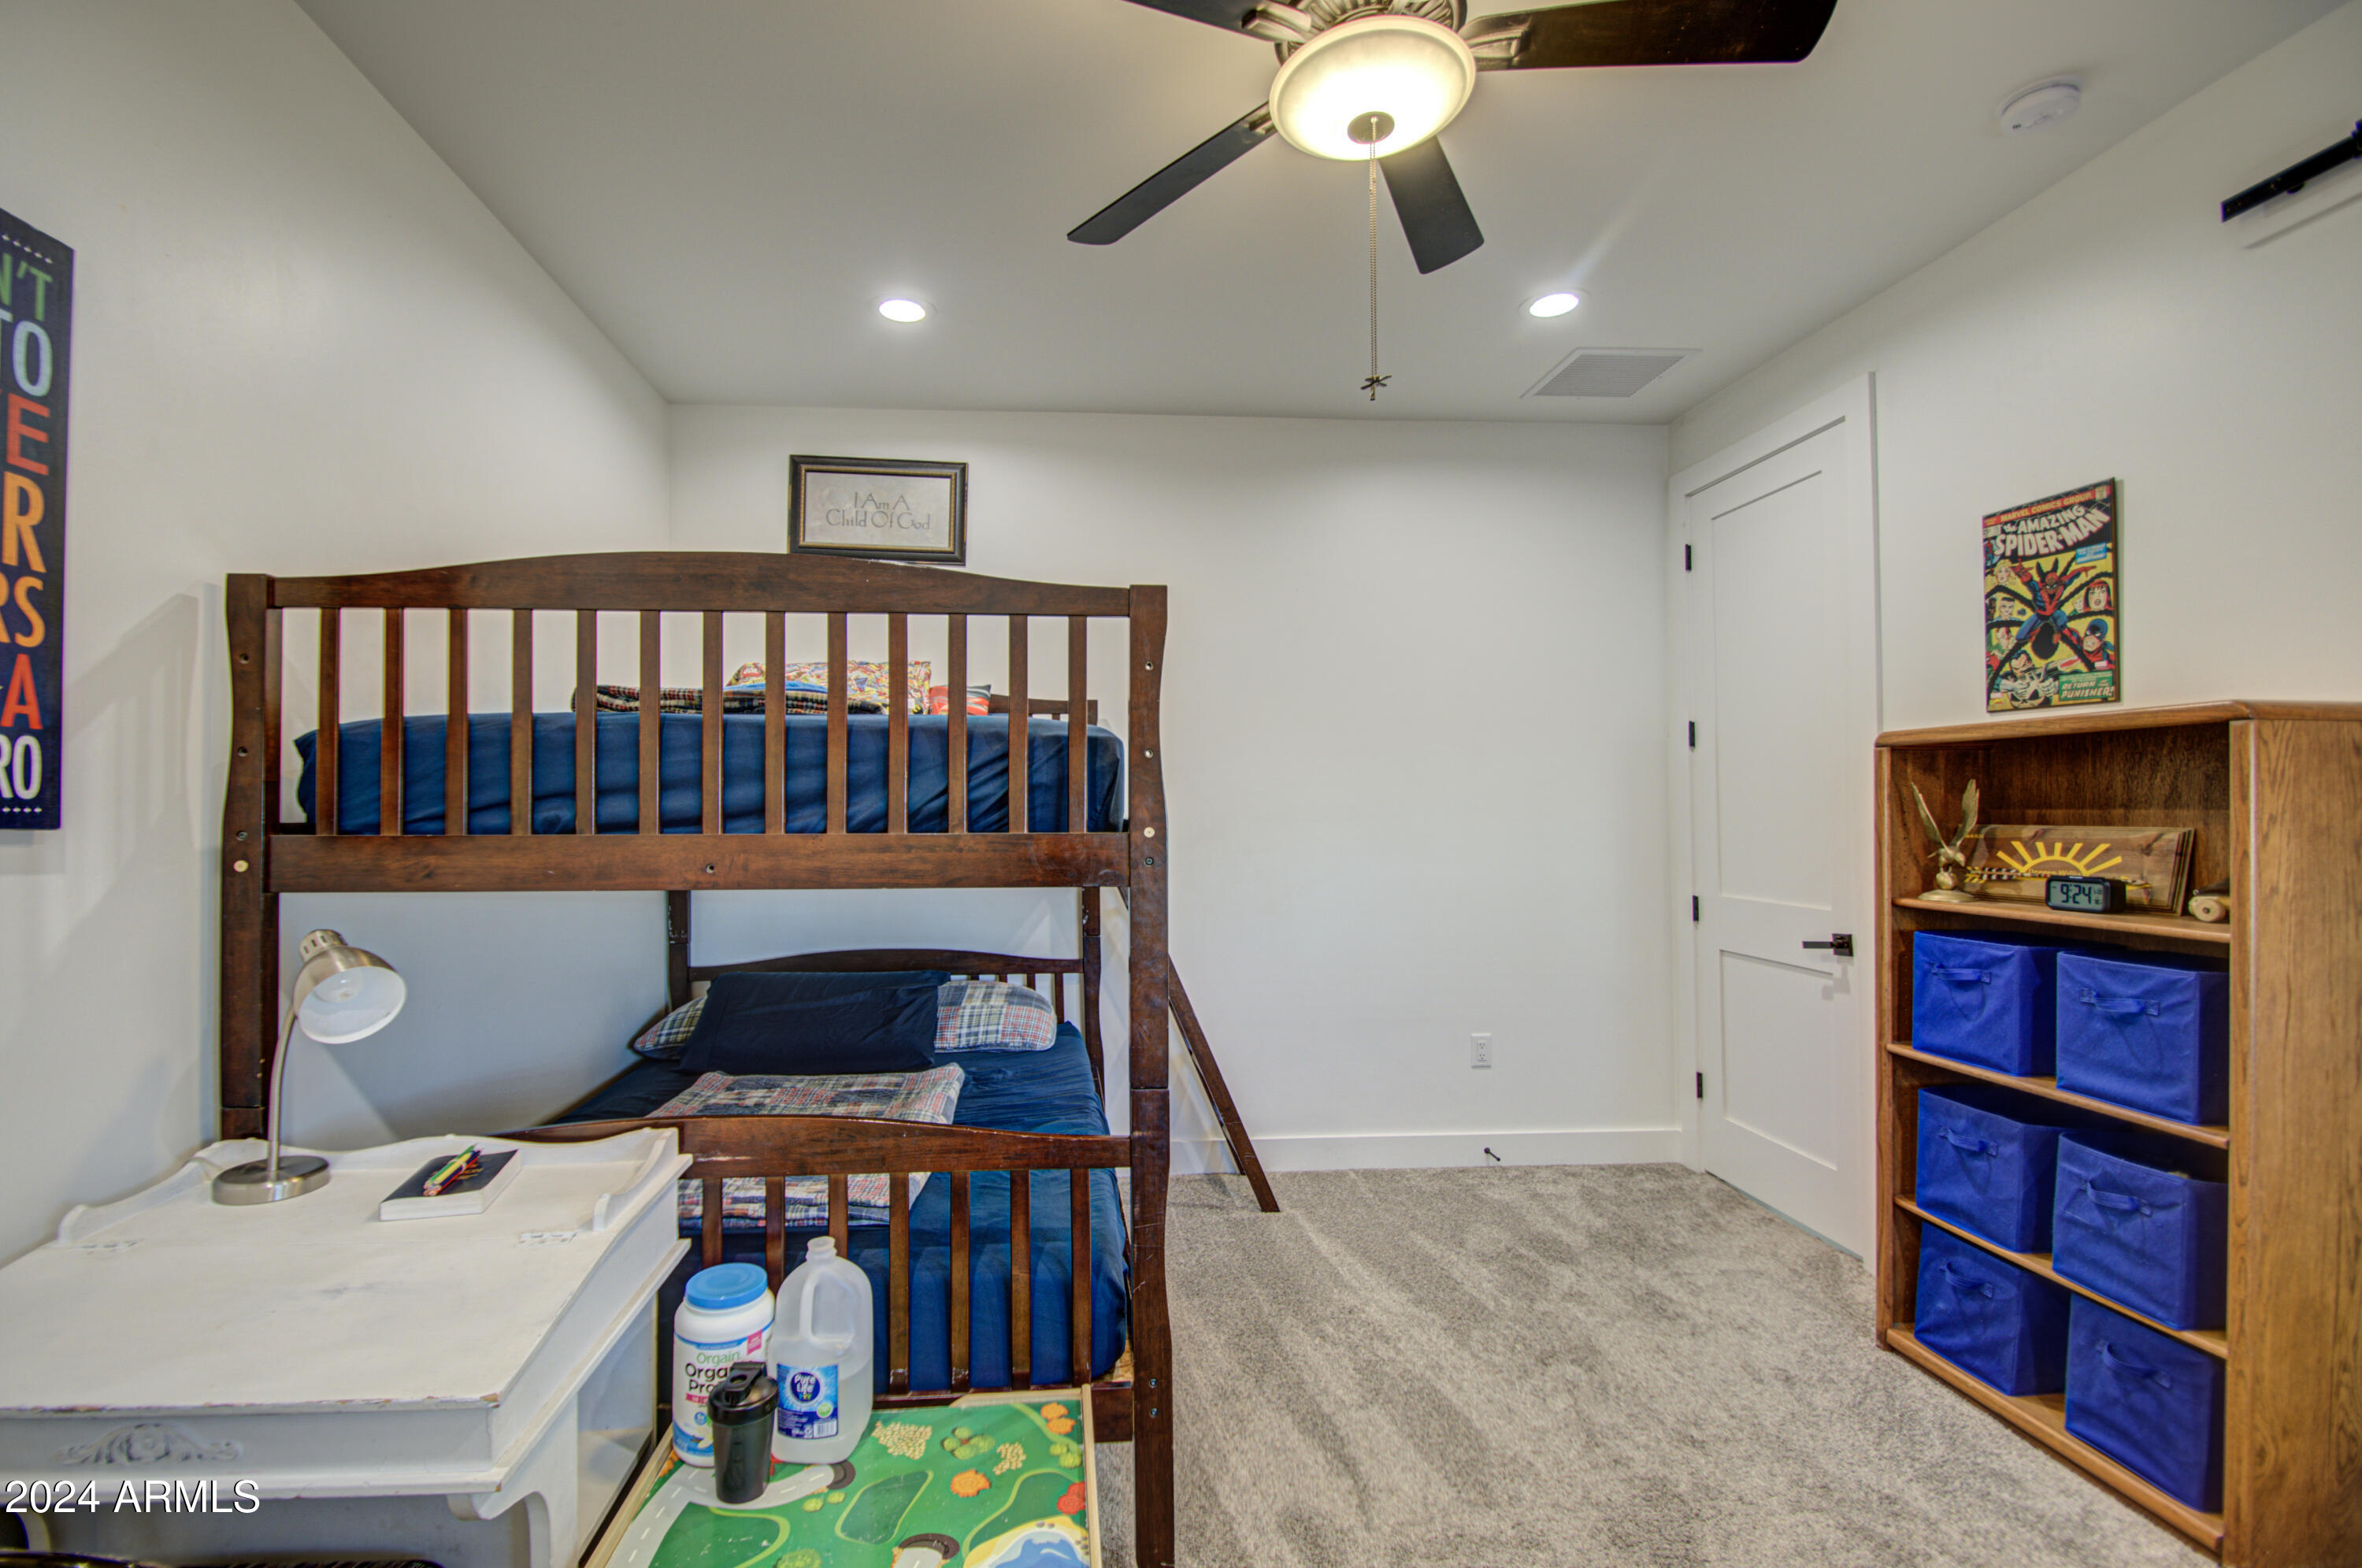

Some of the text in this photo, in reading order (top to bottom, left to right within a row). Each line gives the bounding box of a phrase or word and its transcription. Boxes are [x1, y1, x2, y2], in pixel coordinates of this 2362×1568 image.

[854, 491, 910, 511] I Am A
[2000, 509, 2031, 522] MARVEL
[2031, 500, 2062, 513] COMICS
[825, 508, 867, 528] Child
[871, 510, 895, 528] Of
[2017, 504, 2086, 535] AMAZING
[1993, 506, 2111, 557] SPIDER-MAN
[2060, 686, 2116, 699] PUNISHER!
[2061, 680, 2097, 690] RETURN
[2060, 884, 2092, 904] 9:24
[696, 1351, 740, 1368] Orgain
[685, 1362, 732, 1382] Orga
[794, 1373, 817, 1385] Pure
[796, 1382, 814, 1395] Life
